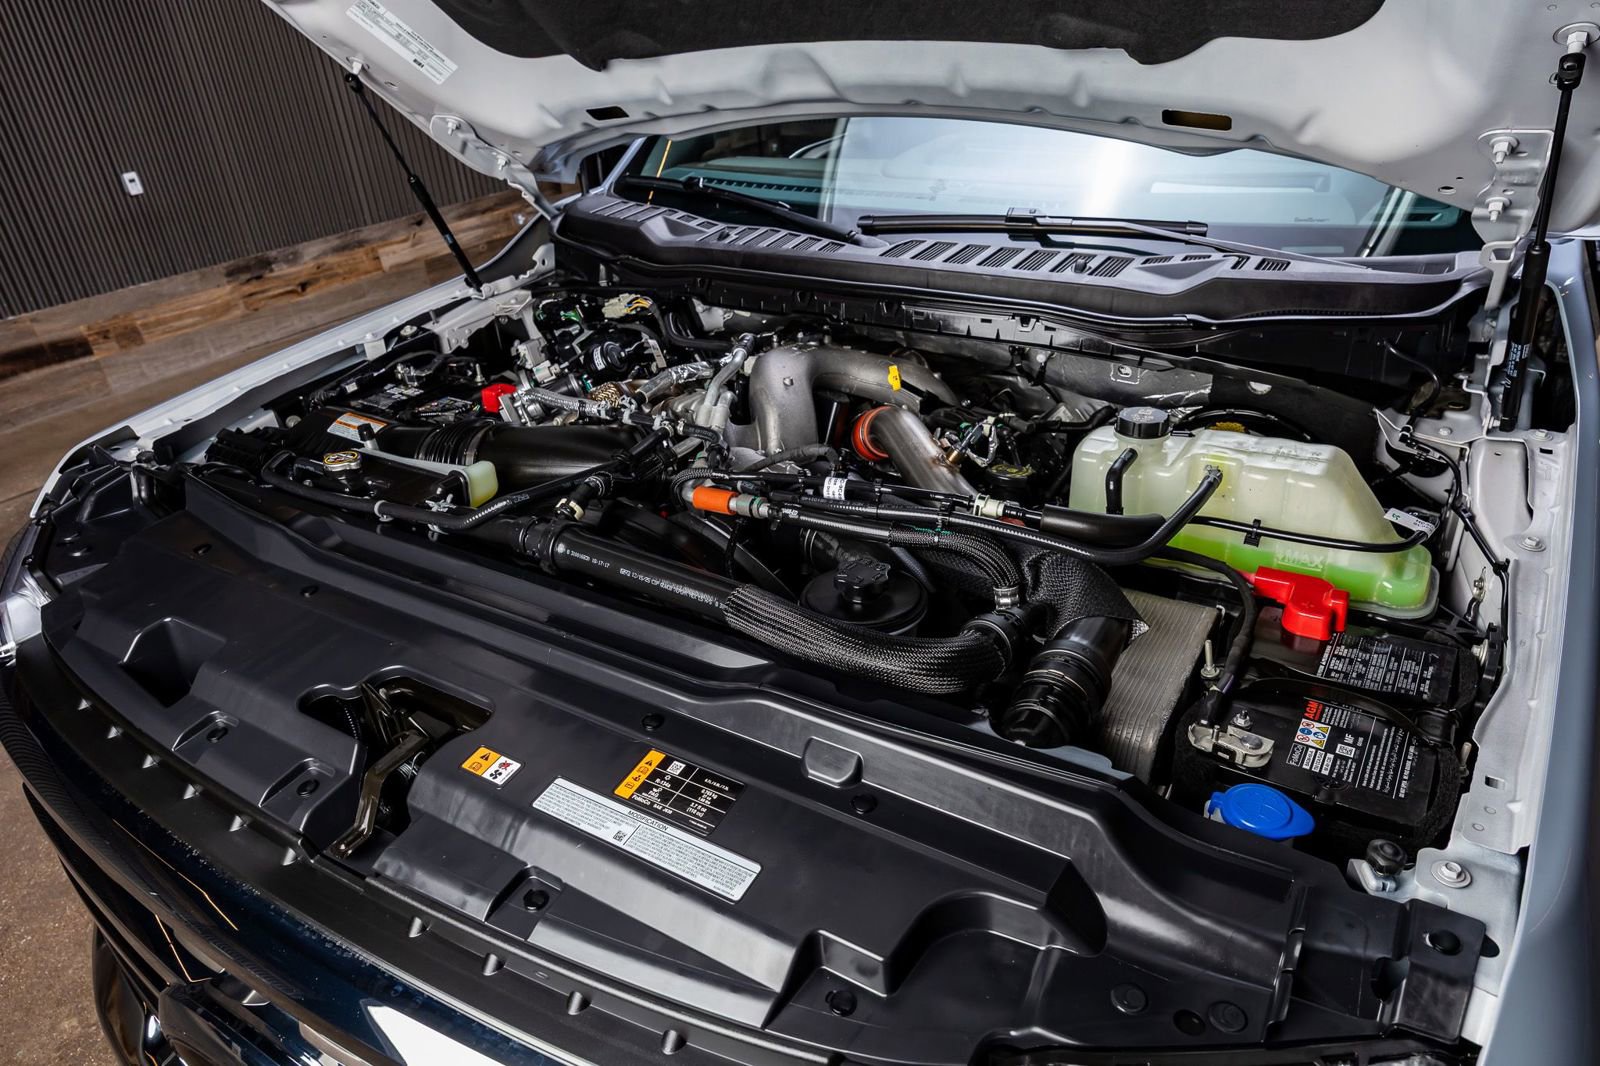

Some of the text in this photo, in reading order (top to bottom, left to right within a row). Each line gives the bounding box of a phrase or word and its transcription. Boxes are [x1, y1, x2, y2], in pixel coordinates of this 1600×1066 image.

[1280, 549, 1326, 568] MAX
[1304, 700, 1319, 719] AGM
[1289, 745, 1303, 765] FoMoCo
[654, 778, 671, 788] R-134a
[632, 794, 651, 806] FoMoCo
[627, 810, 669, 831] MODIFICATION
